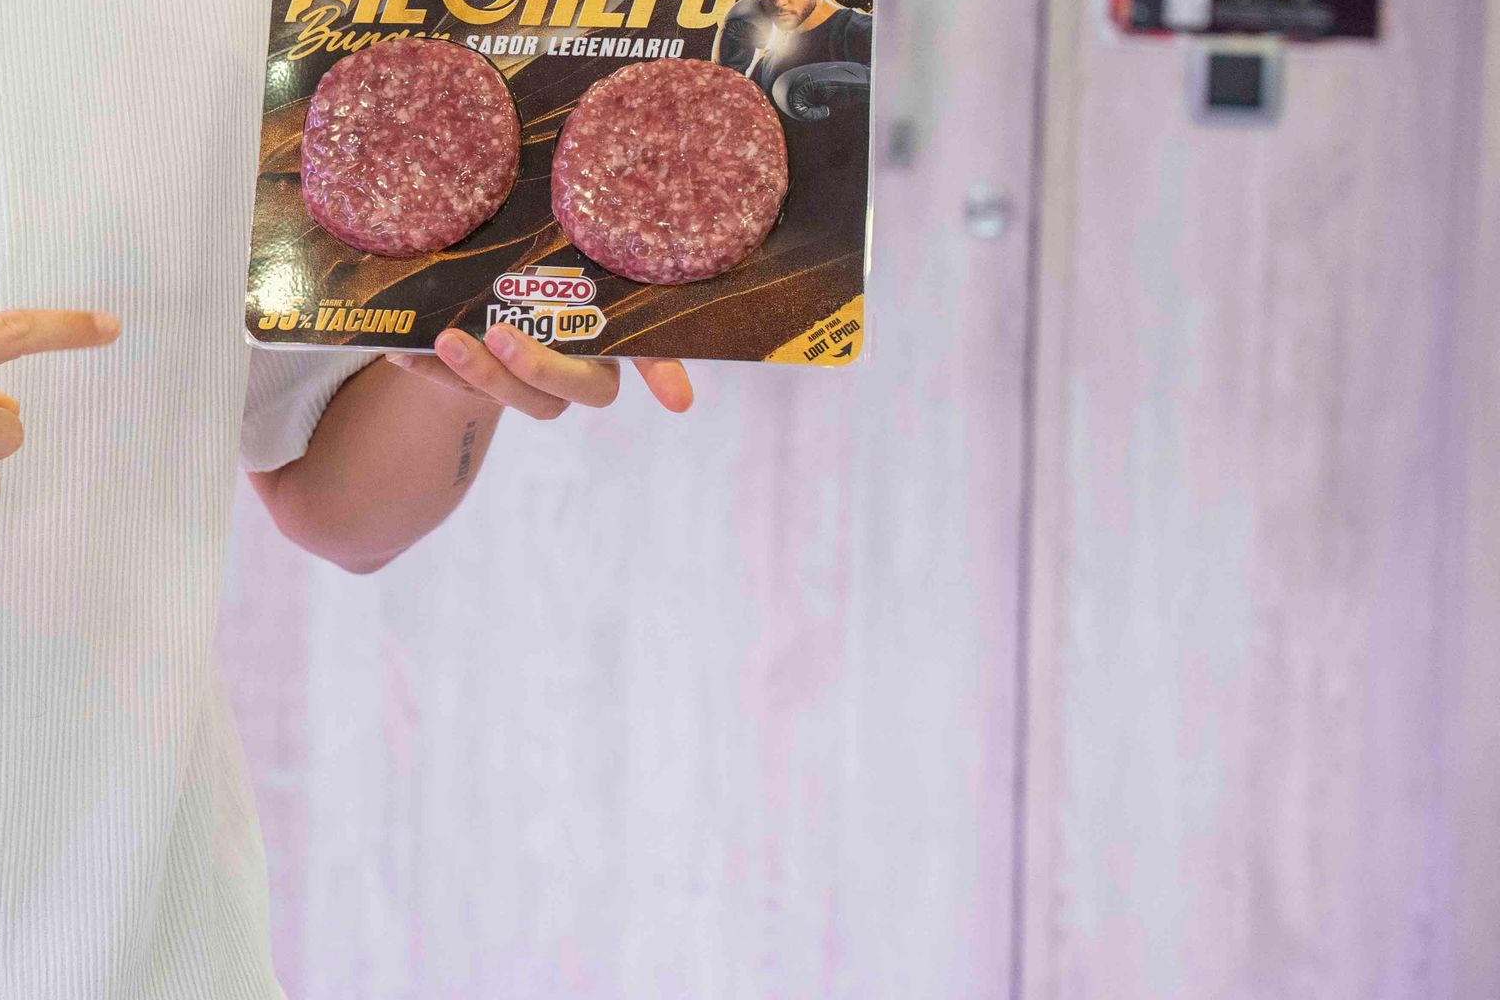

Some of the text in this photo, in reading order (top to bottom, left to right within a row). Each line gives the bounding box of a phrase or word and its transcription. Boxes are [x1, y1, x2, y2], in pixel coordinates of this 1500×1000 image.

[465, 34, 685, 59] SABOR LEGENDARIO
[319, 298, 345, 307] CARNE
[314, 307, 417, 334] VACUNO
[824, 317, 841, 331] PARA
[803, 319, 861, 361] LOOT ÉPICO
